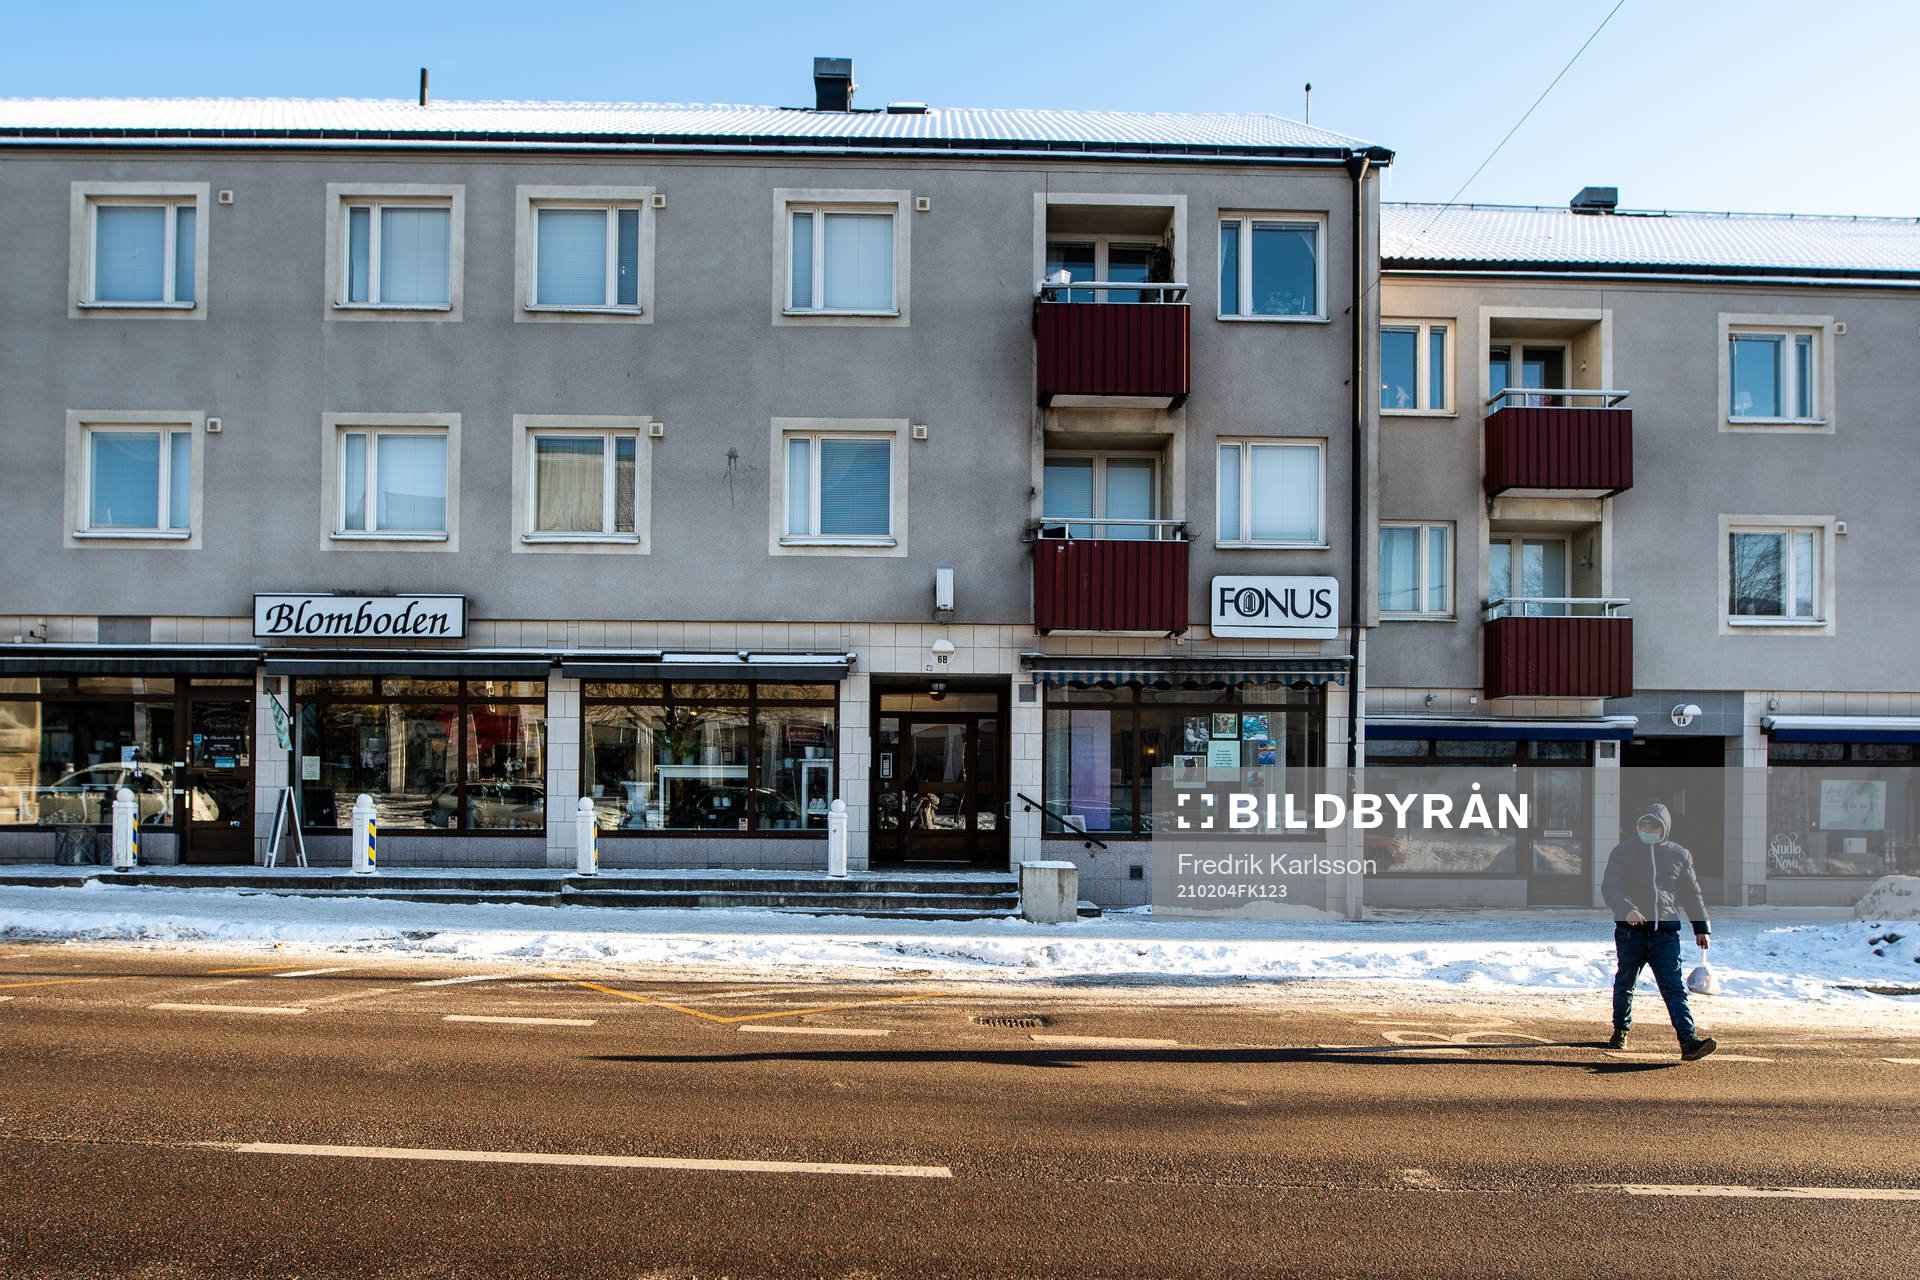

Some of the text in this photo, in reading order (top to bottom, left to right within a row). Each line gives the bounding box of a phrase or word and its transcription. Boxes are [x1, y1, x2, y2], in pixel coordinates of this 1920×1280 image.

[1219, 587, 1332, 619] FONUS
[265, 600, 451, 635] Blomboden
[937, 655, 948, 664] 6B
[1775, 856, 1799, 871] Nova
